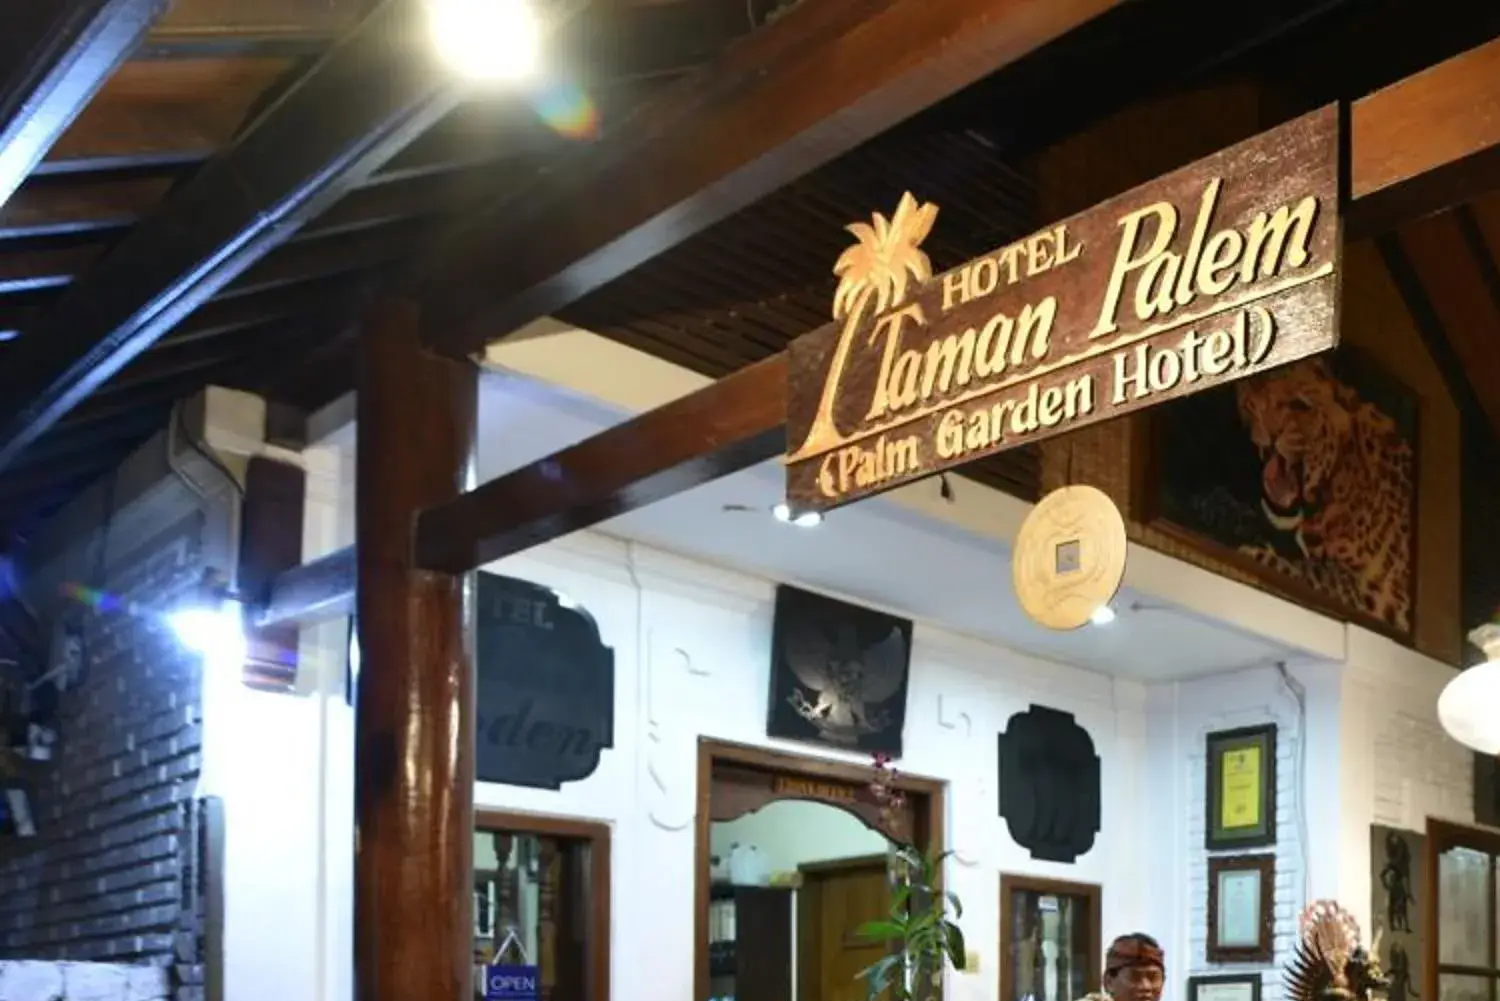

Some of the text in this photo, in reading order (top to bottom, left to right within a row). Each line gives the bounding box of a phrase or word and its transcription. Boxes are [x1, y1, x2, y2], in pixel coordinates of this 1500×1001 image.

[866, 177, 1318, 421] Taman Palem
[941, 224, 1084, 310] HOTEL
[938, 372, 1093, 459] Garden
[493, 596, 554, 629] TEL
[491, 974, 535, 991] OPEN
